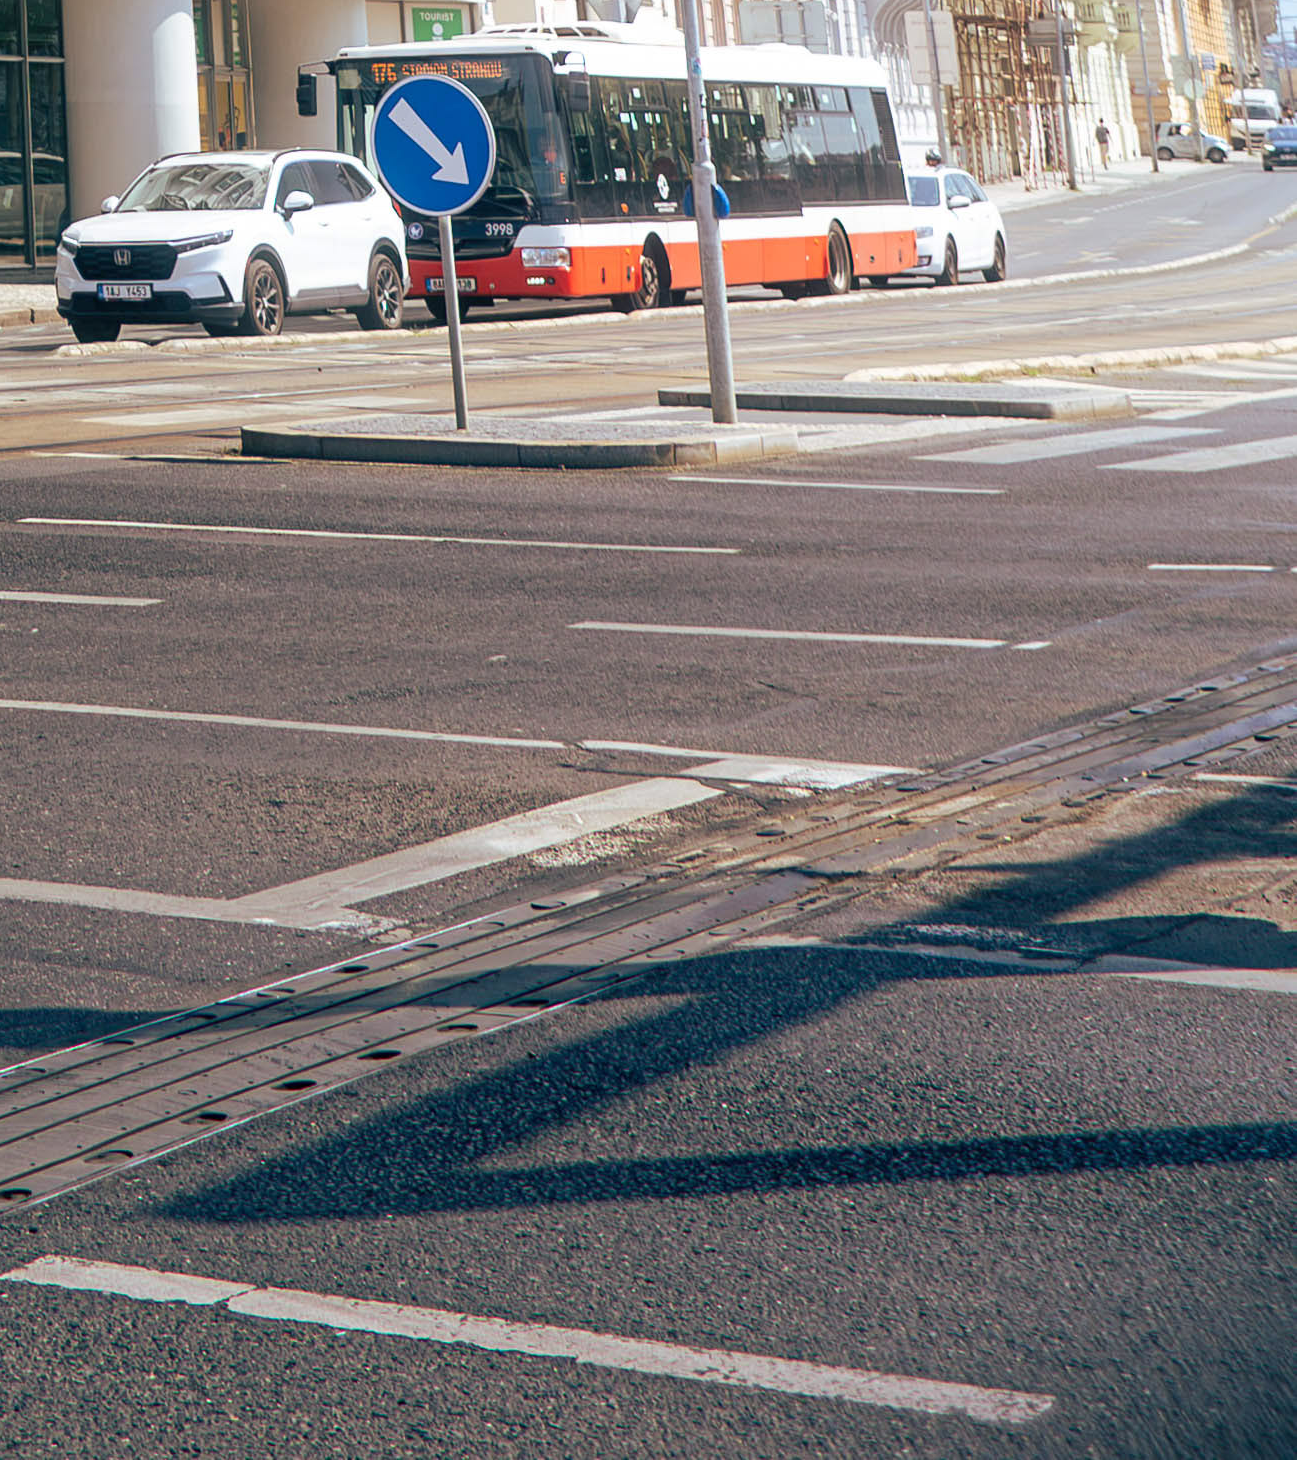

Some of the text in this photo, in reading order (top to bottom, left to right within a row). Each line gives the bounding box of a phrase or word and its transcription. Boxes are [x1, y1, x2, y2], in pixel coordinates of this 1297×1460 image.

[419, 11, 455, 21] TOURIST
[371, 62, 398, 83] 176
[484, 223, 514, 237] 3998
[125, 286, 147, 297] Y453
